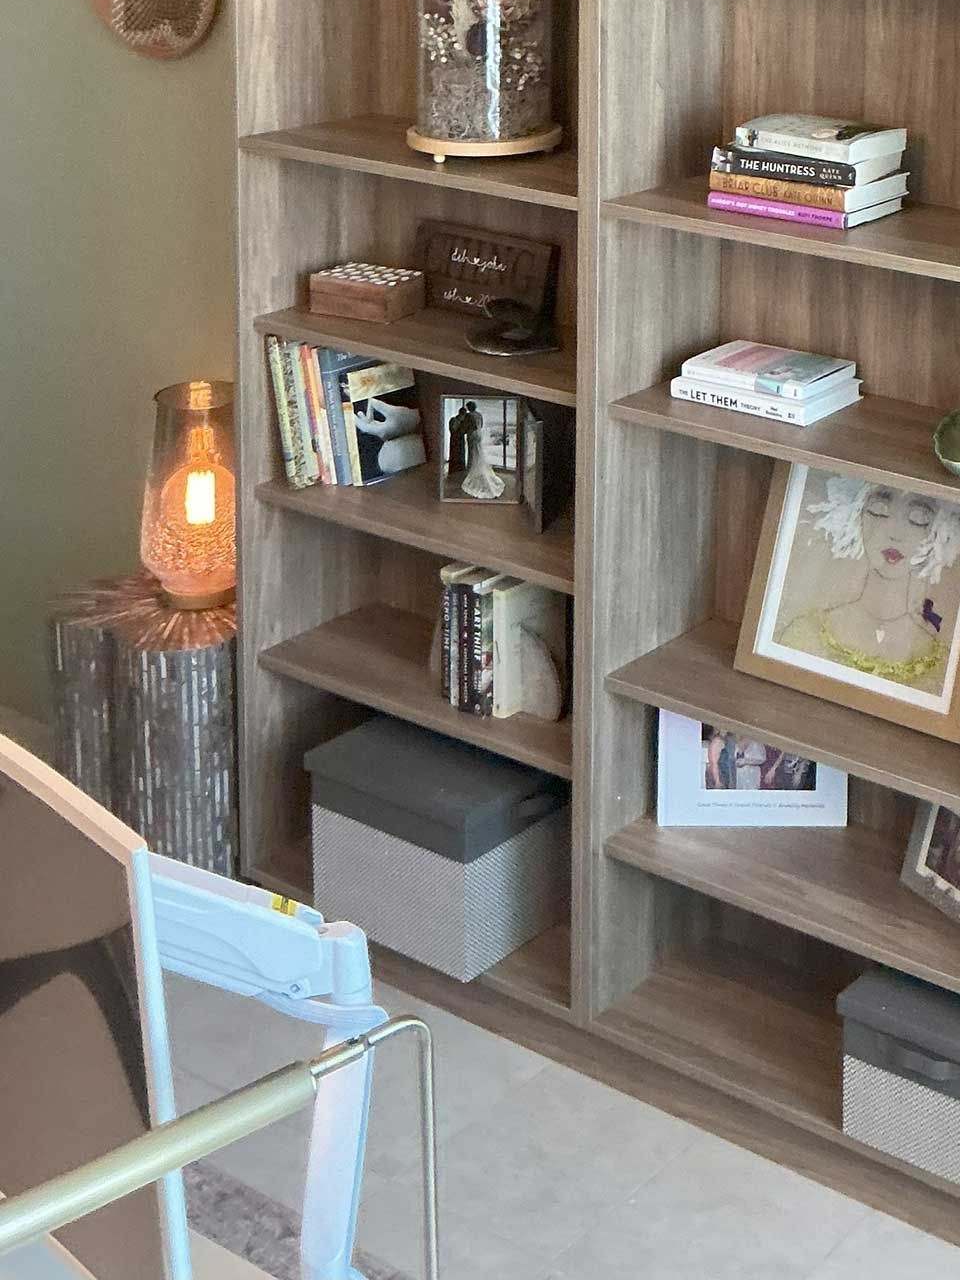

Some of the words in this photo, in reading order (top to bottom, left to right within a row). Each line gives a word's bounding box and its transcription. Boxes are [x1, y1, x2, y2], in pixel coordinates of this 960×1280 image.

[739, 158, 759, 170] THE
[761, 161, 816, 177] HUNTRESS
[690, 389, 707, 403] LET
[710, 393, 738, 408] THEM
[473, 631, 481, 661] THIEF
